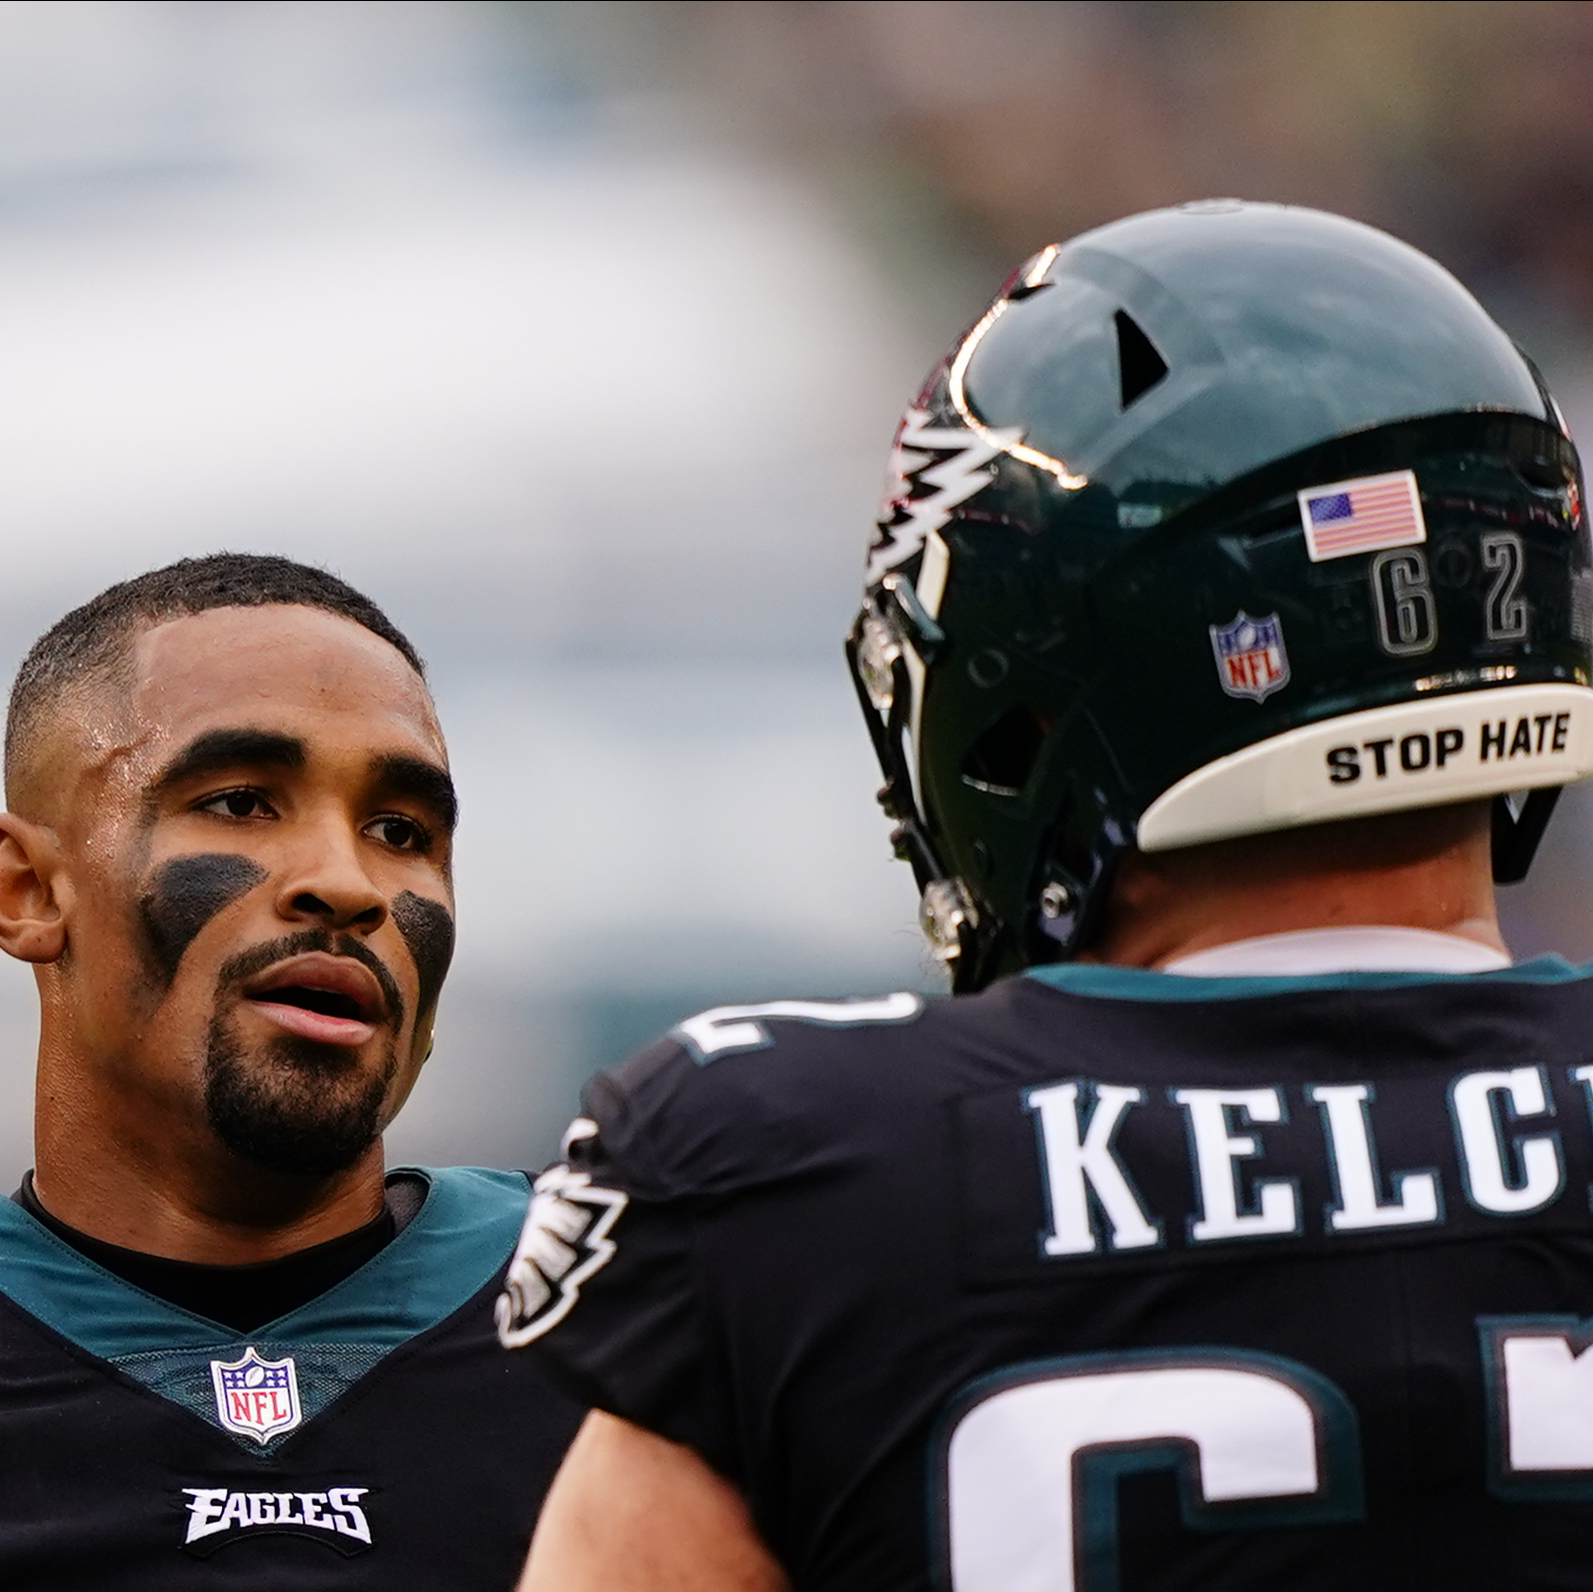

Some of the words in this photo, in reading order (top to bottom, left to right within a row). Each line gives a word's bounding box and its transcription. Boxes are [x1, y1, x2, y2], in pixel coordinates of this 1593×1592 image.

[1226, 650, 1283, 689] NFL
[1326, 728, 1465, 784] STOP
[1480, 711, 1570, 762] HATE
[230, 1391, 288, 1426] NFL
[181, 1487, 372, 1545] EAGLES
